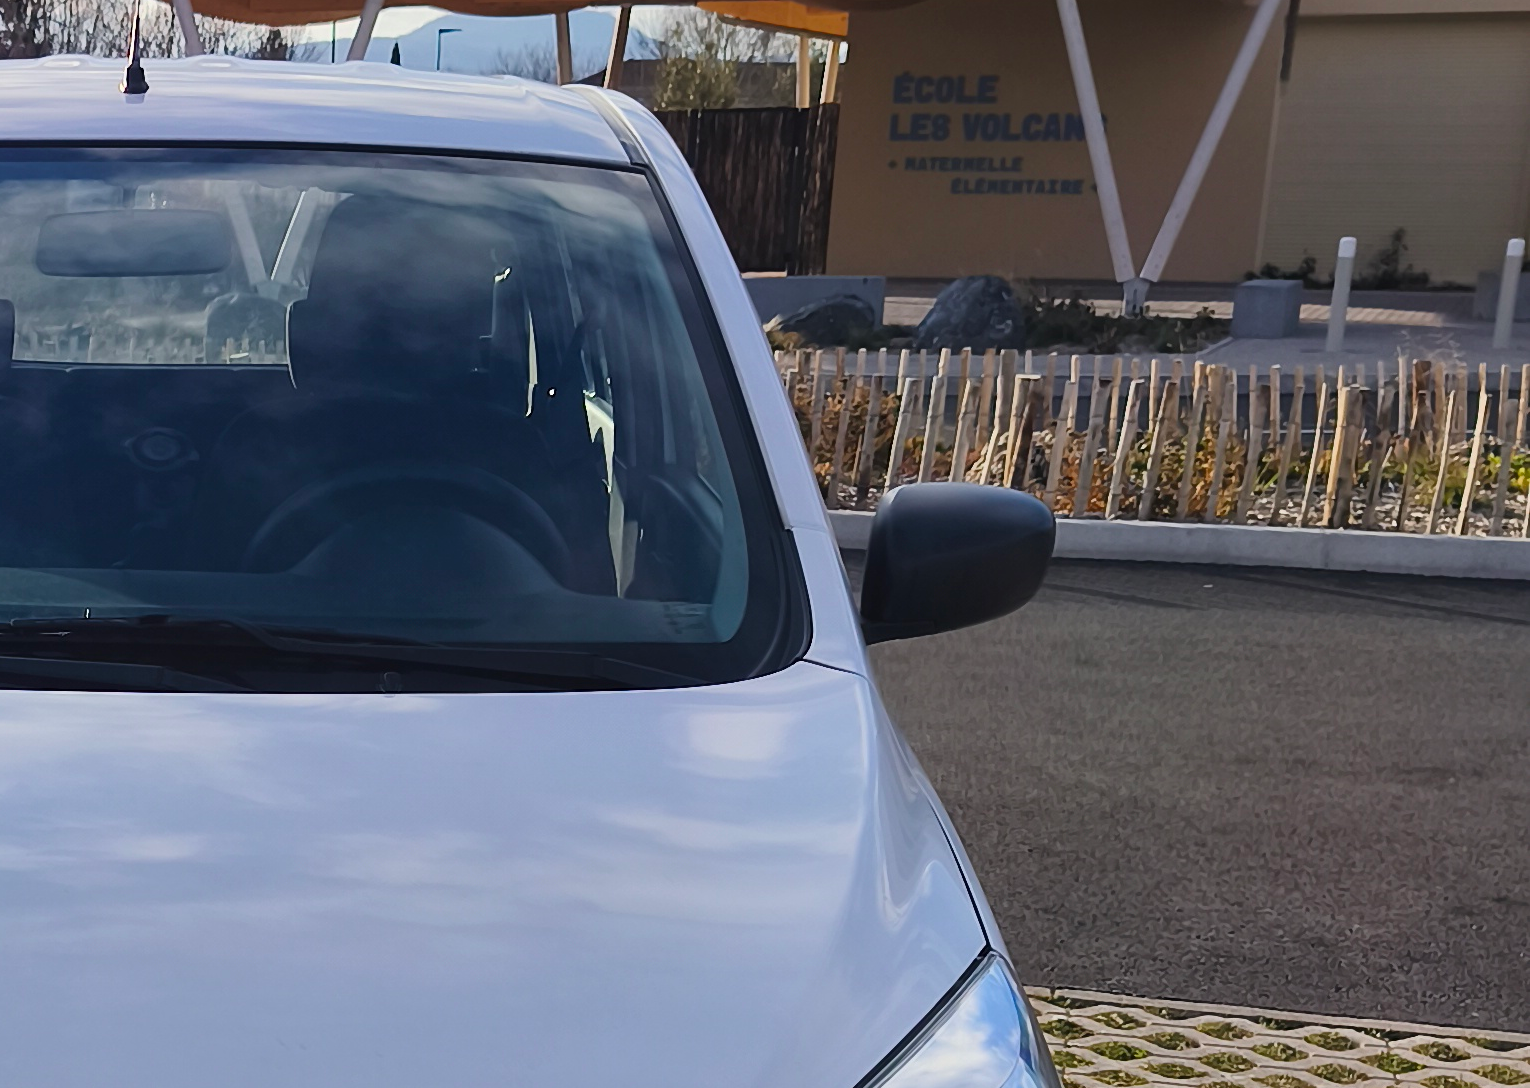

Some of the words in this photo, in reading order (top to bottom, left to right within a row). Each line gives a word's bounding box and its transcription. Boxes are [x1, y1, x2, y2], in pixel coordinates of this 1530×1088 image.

[893, 71, 1000, 104] ÉCOLE
[889, 113, 951, 142] LES
[962, 113, 1107, 142] VOLCAN
[904, 157, 1024, 172] MATERNELLE
